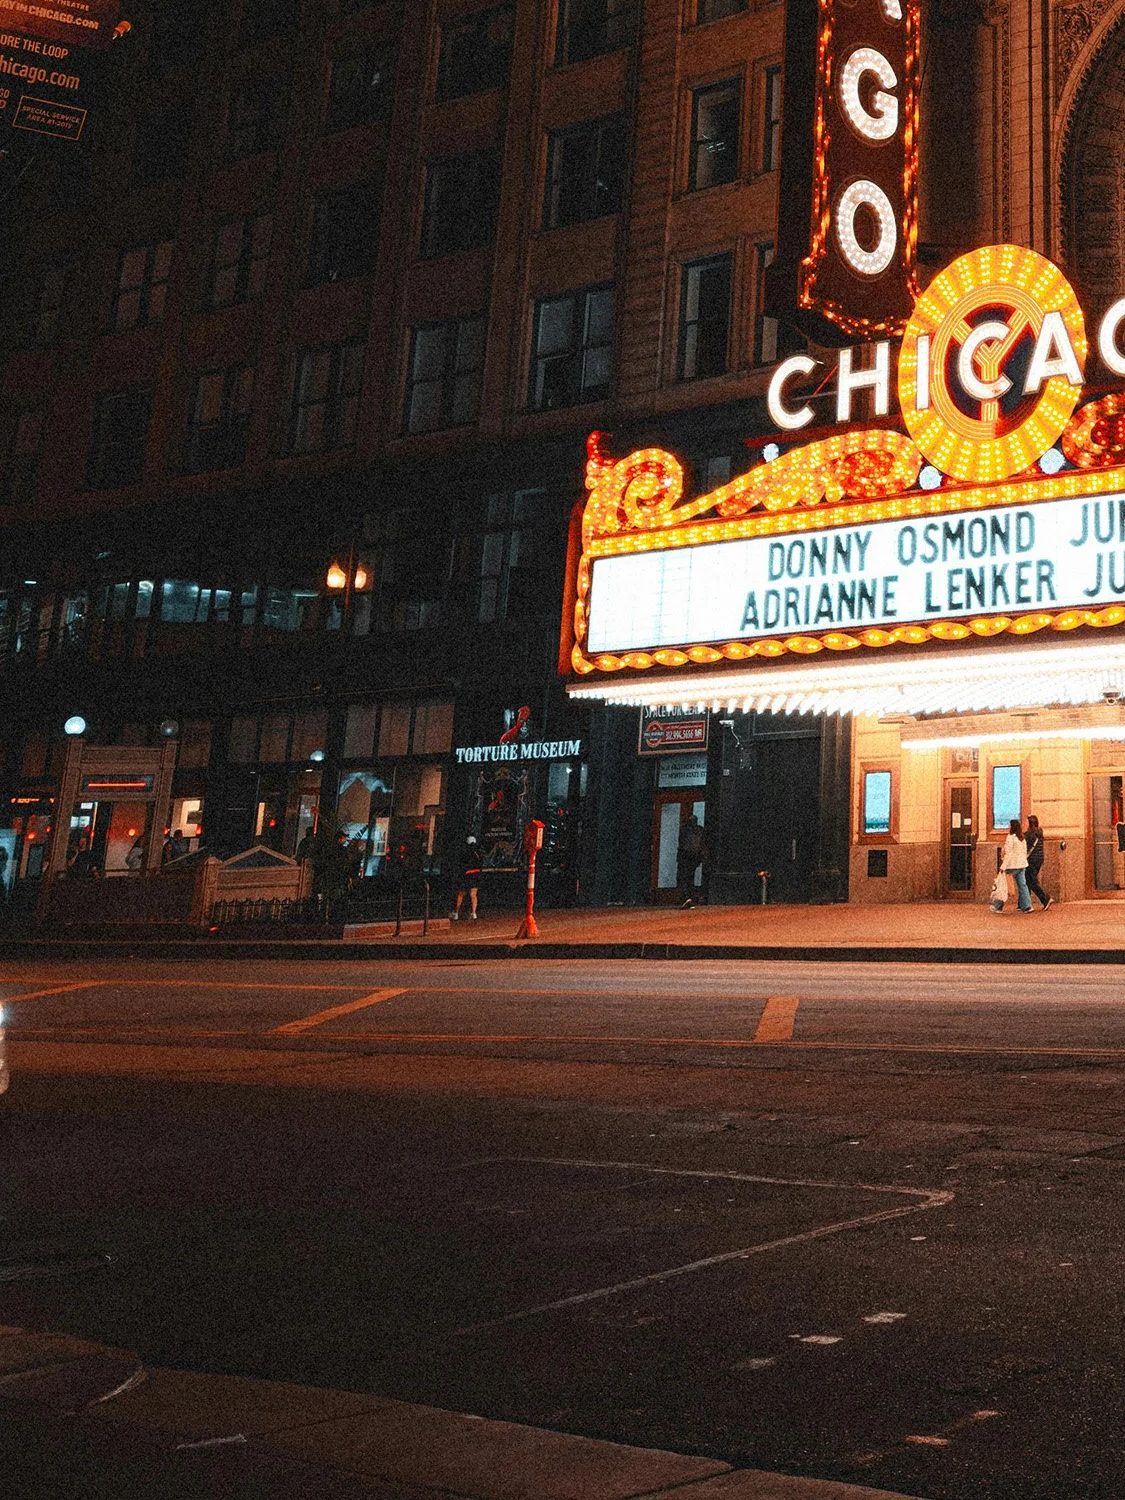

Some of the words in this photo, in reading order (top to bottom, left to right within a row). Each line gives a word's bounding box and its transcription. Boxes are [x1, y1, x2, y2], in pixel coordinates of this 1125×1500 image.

[57, 0, 90, 12] THEATRE
[23, 39, 42, 53] THE
[42, 44, 69, 59] LOOP
[767, 531, 873, 581] DONNY
[897, 511, 1036, 567] OSMOND
[739, 574, 900, 631] ADRIANNE
[925, 558, 1057, 613] LENKER
[455, 742, 518, 763] TORTURE
[520, 739, 581, 759] MUSEUM
